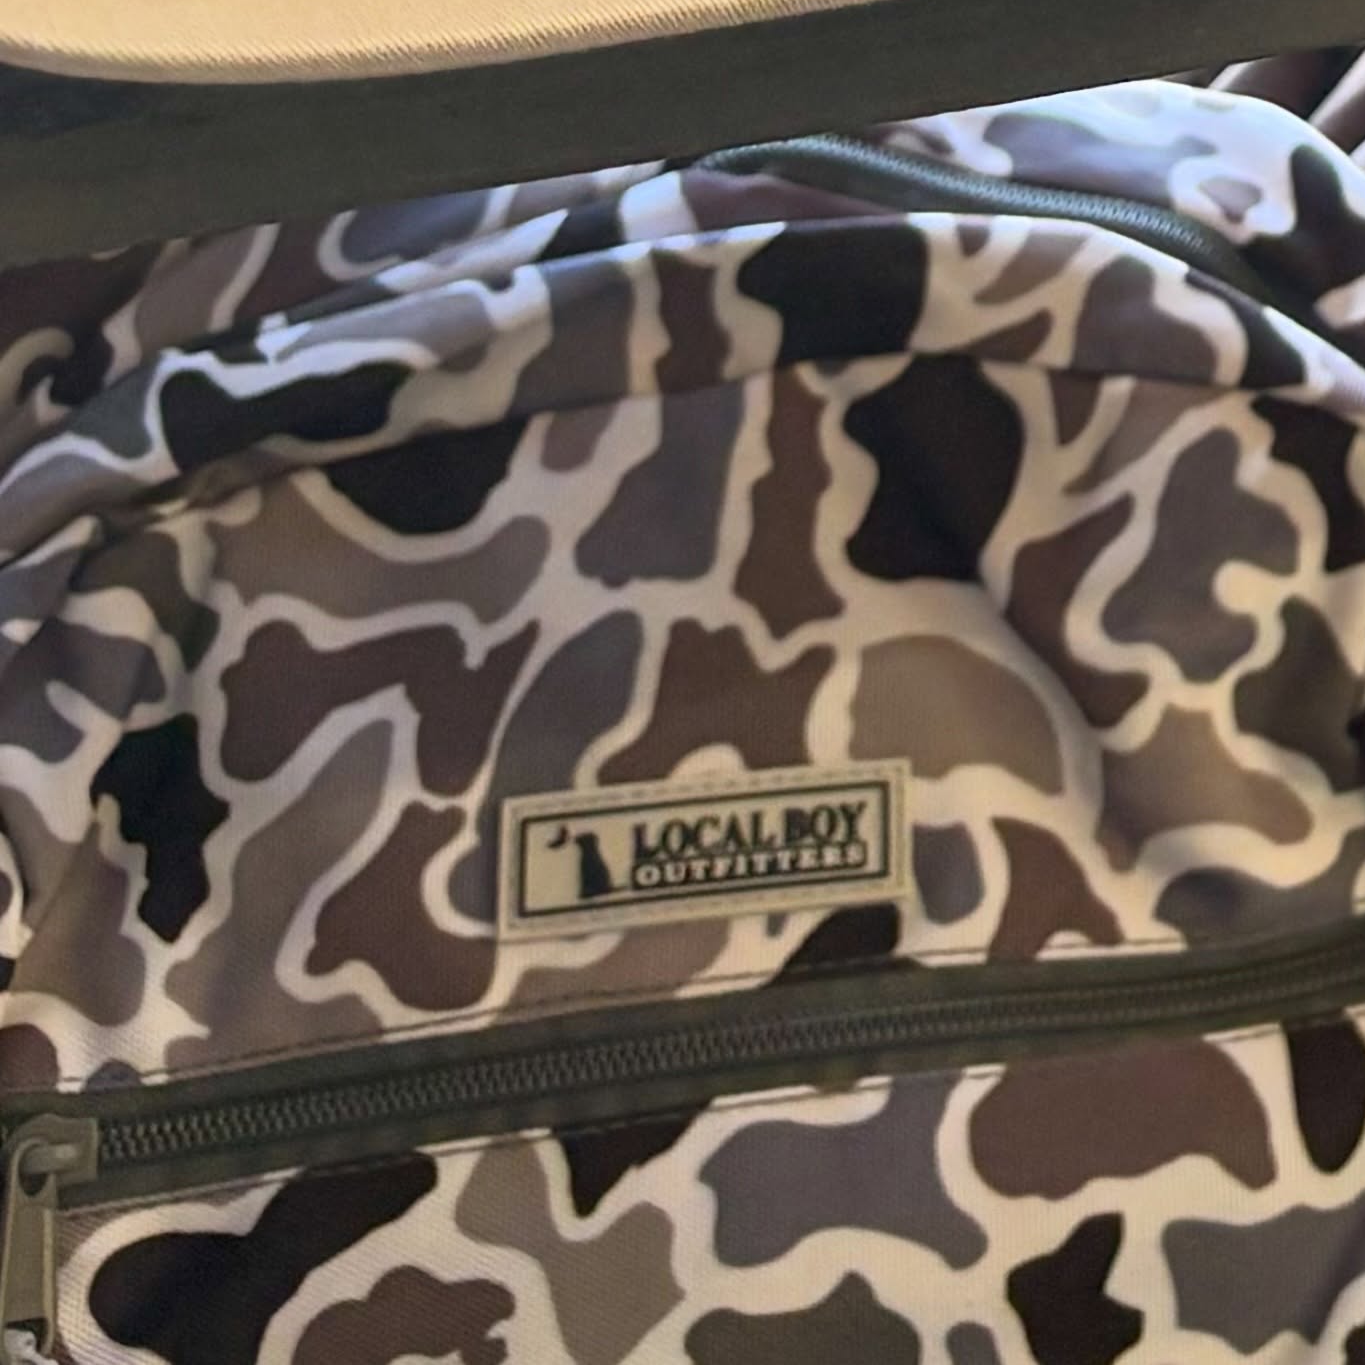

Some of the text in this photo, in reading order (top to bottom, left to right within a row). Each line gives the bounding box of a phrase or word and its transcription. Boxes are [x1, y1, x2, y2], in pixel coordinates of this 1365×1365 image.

[632, 800, 868, 860] LOCAL BOY
[635, 845, 866, 886] OUTFITTERS
